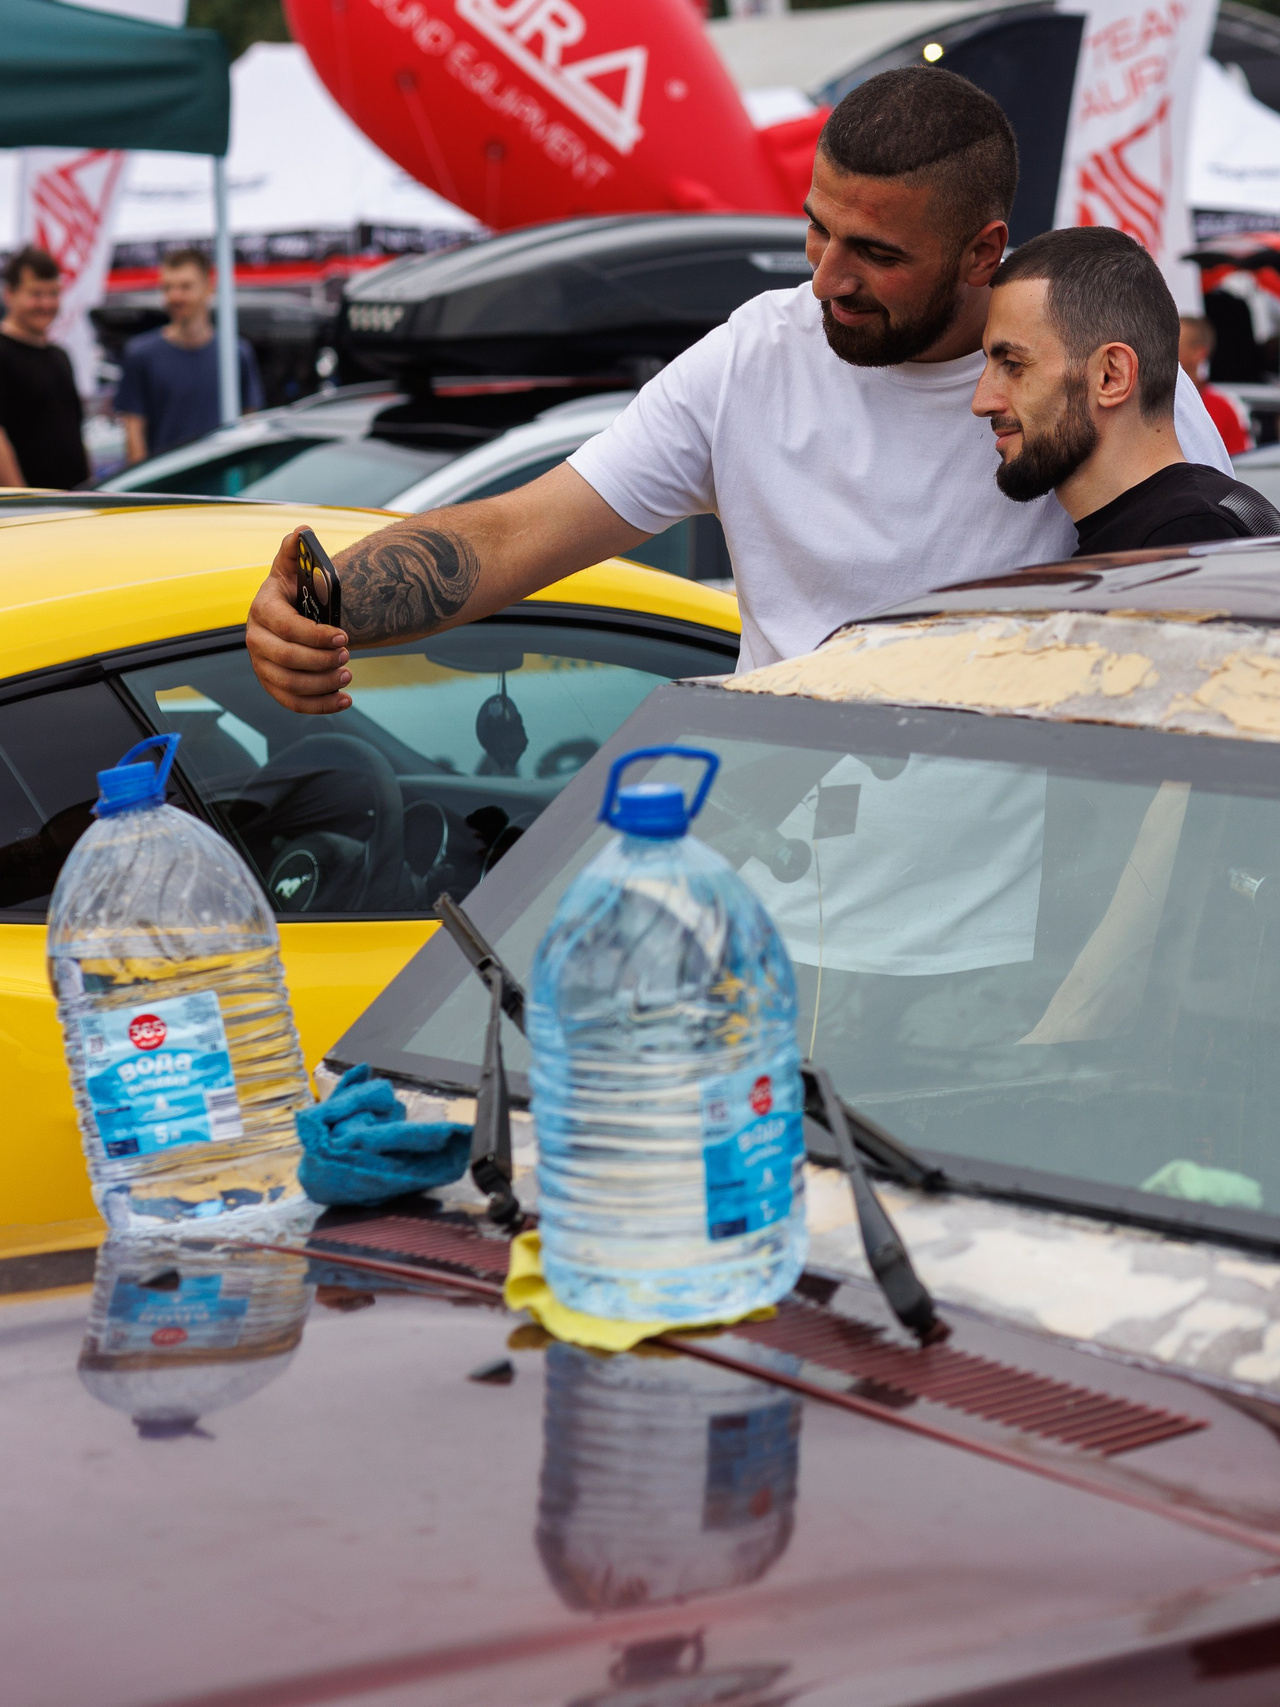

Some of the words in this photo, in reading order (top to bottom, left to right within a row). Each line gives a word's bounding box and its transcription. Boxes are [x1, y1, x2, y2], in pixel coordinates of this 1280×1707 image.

[444, 40, 616, 189] EQUIPMENT
[455, 0, 649, 132] URA
[129, 1020, 167, 1041] 365
